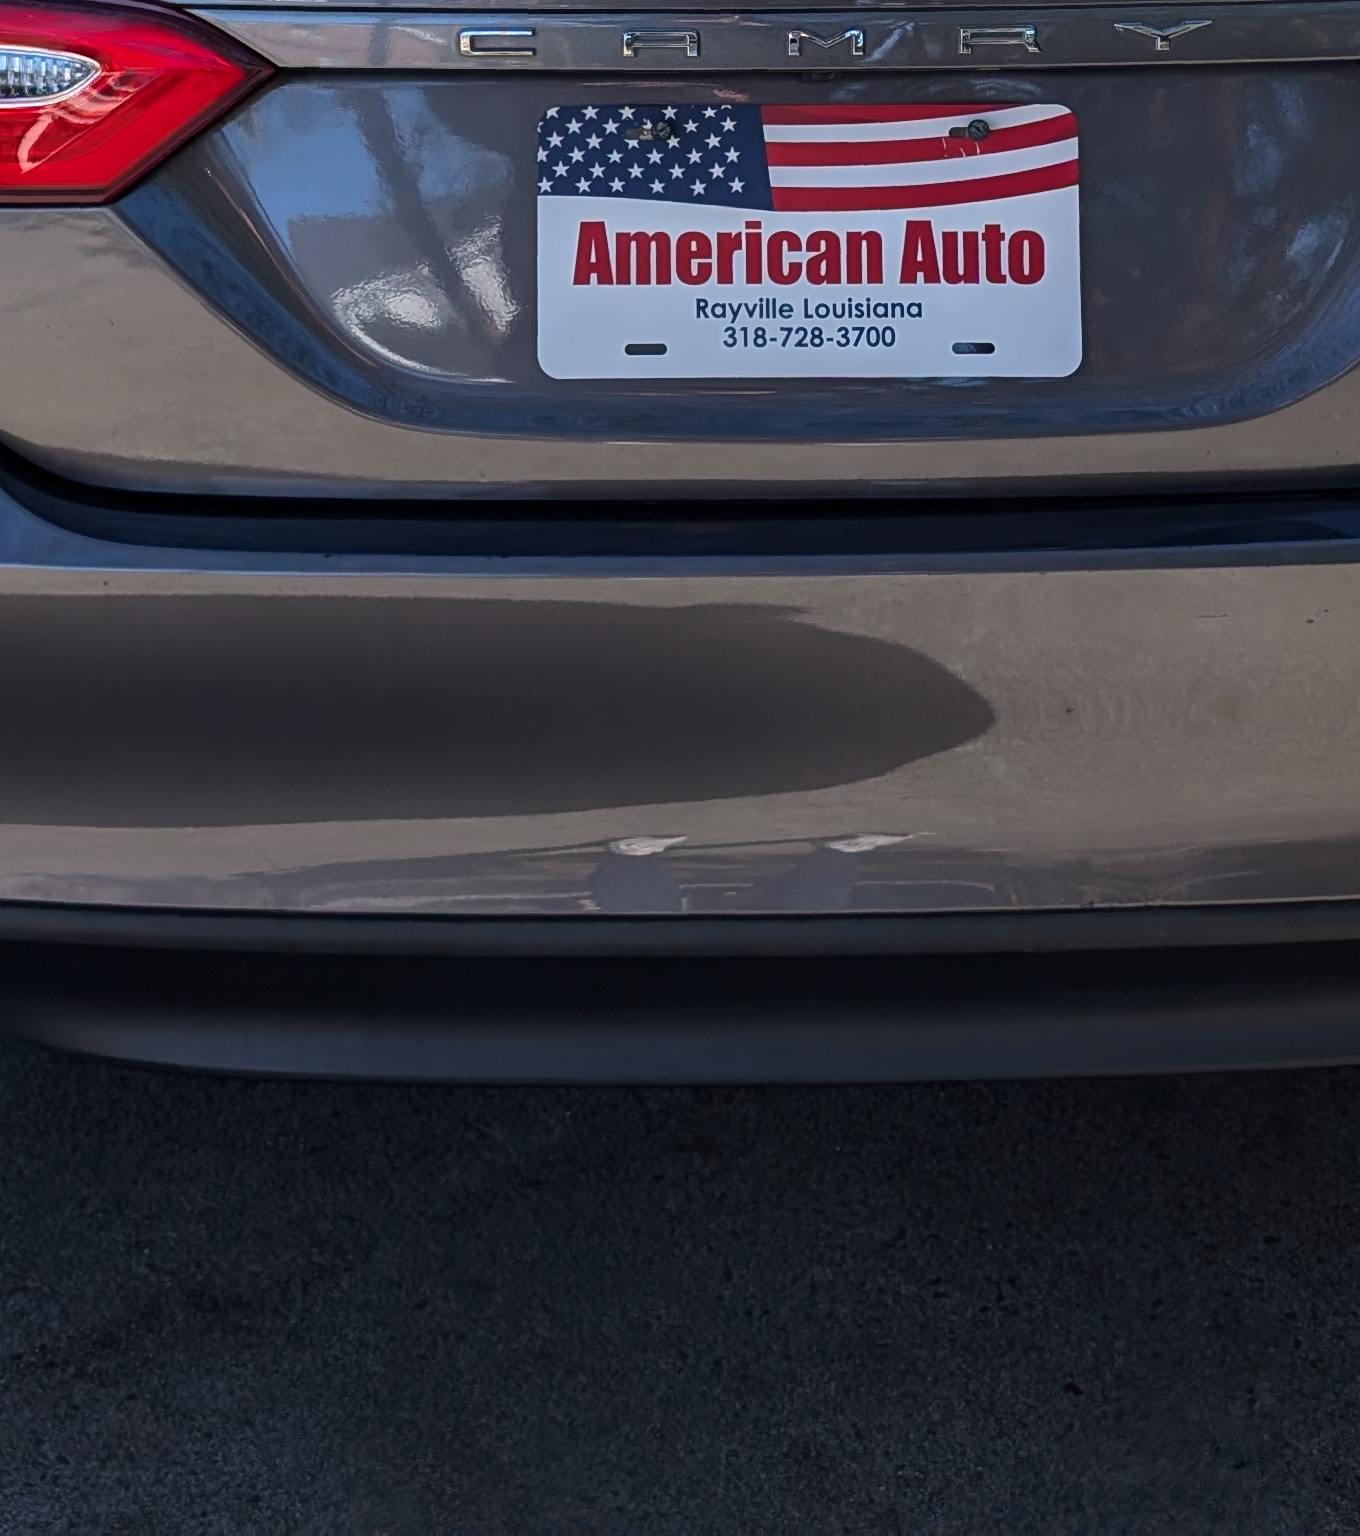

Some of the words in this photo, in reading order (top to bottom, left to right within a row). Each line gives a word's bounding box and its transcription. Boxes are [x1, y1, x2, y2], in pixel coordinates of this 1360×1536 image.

[460, 20, 1212, 57] CAMRY
[572, 219, 883, 286] American
[899, 219, 1046, 285] Auto
[695, 298, 794, 324] Rayville
[803, 298, 923, 320] Louisiana
[722, 326, 896, 348] 318-728-3700
